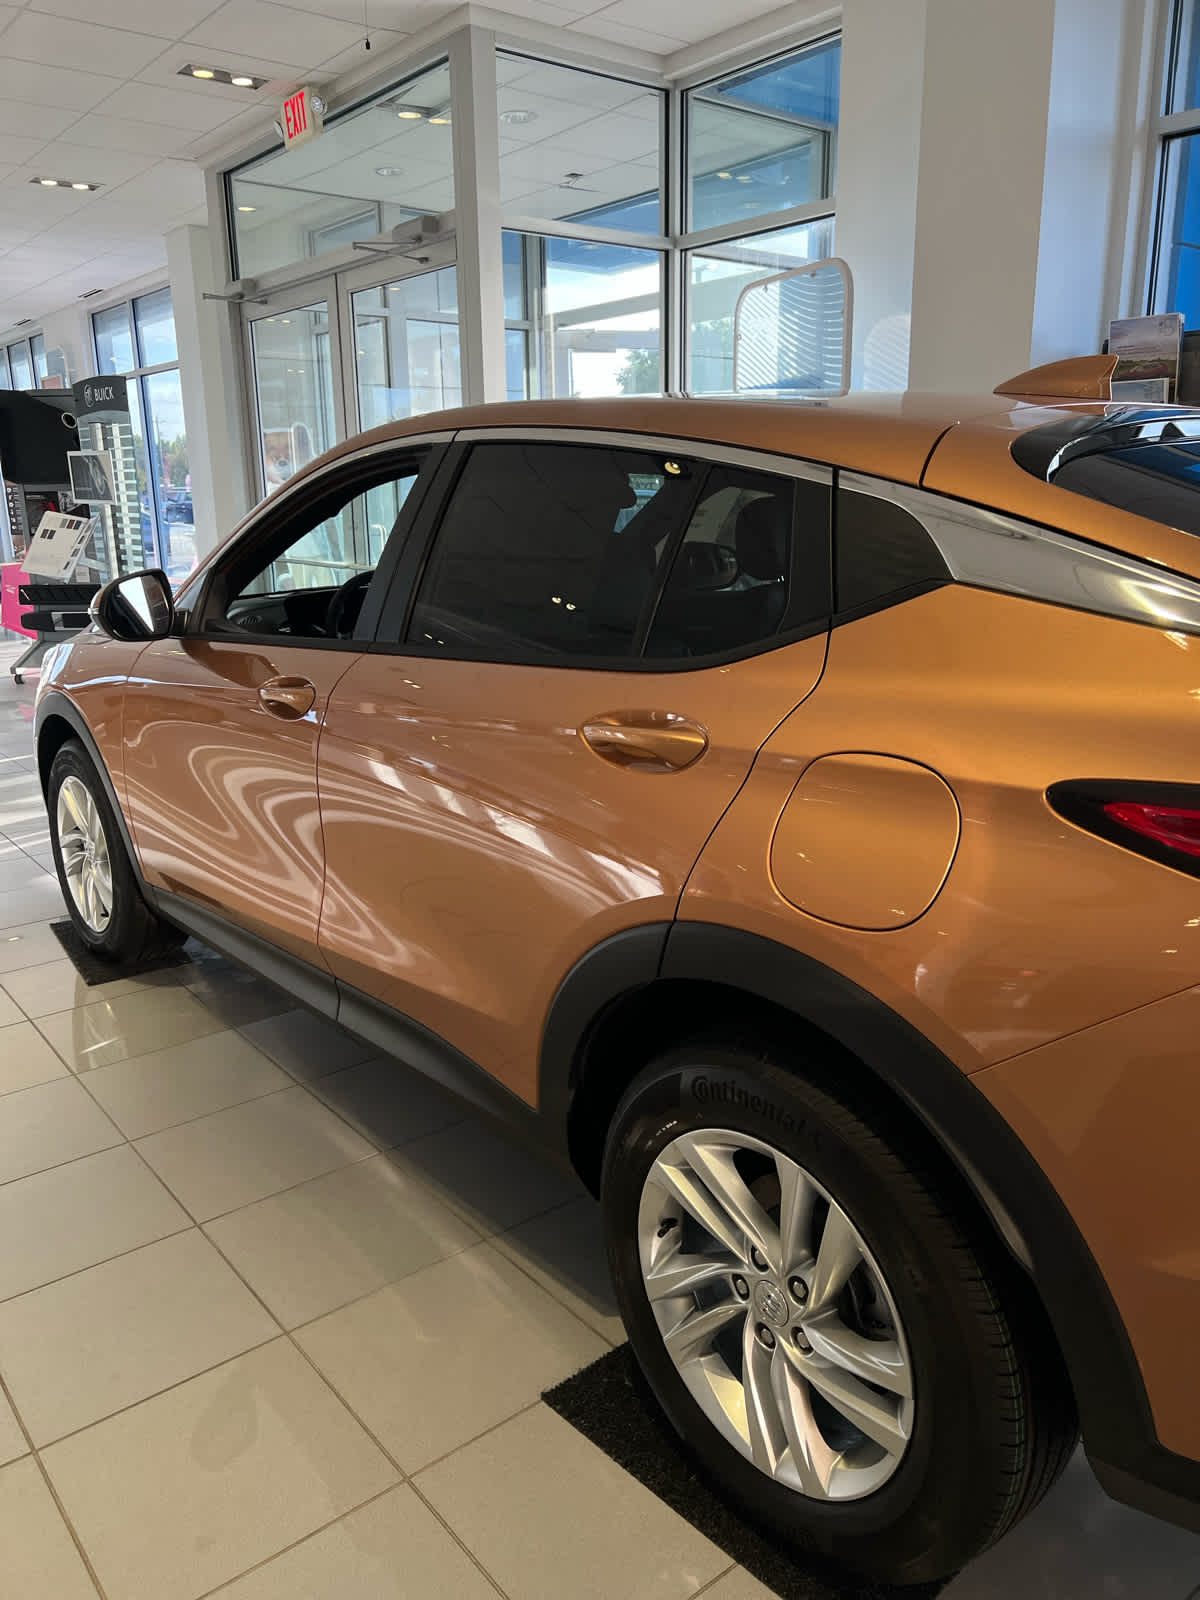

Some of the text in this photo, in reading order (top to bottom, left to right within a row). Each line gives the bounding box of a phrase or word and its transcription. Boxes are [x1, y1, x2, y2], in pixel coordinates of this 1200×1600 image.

[284, 91, 308, 139] EXIT
[94, 386, 114, 401] BUICK
[691, 1076, 807, 1134] Continental
